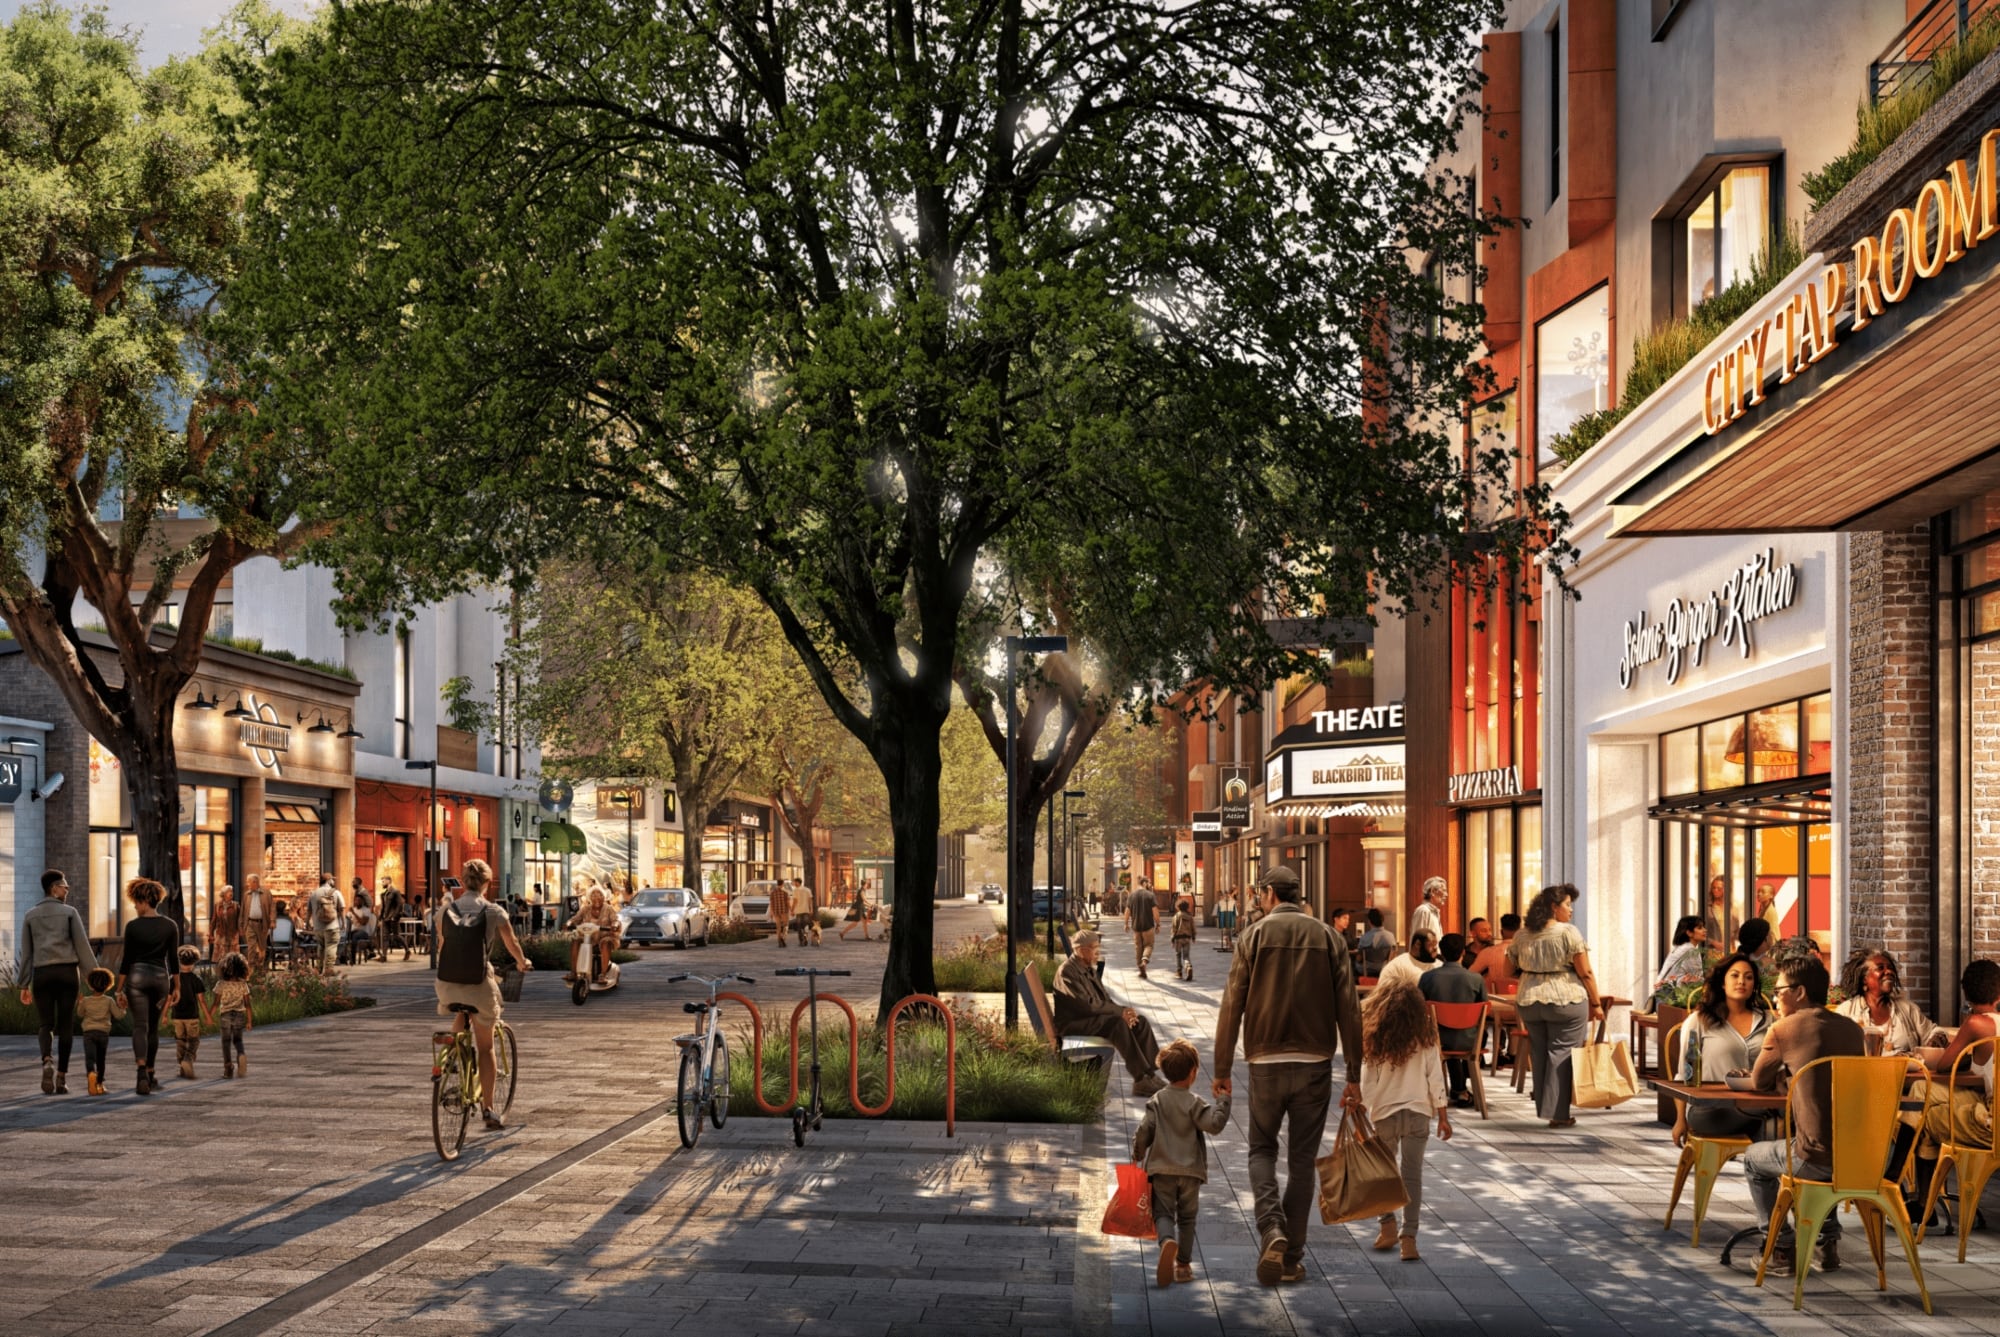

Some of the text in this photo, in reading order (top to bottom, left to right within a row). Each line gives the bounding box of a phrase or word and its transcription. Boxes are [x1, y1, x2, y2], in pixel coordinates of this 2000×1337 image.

[1702, 127, 2000, 436] CITY TAP ROOM
[1619, 547, 1798, 690] Solano Burger Kitchen
[1311, 704, 1406, 734] THEATE
[1312, 765, 1405, 785] BLACKBIRD THEA
[1448, 765, 1522, 804] PIZZERIA
